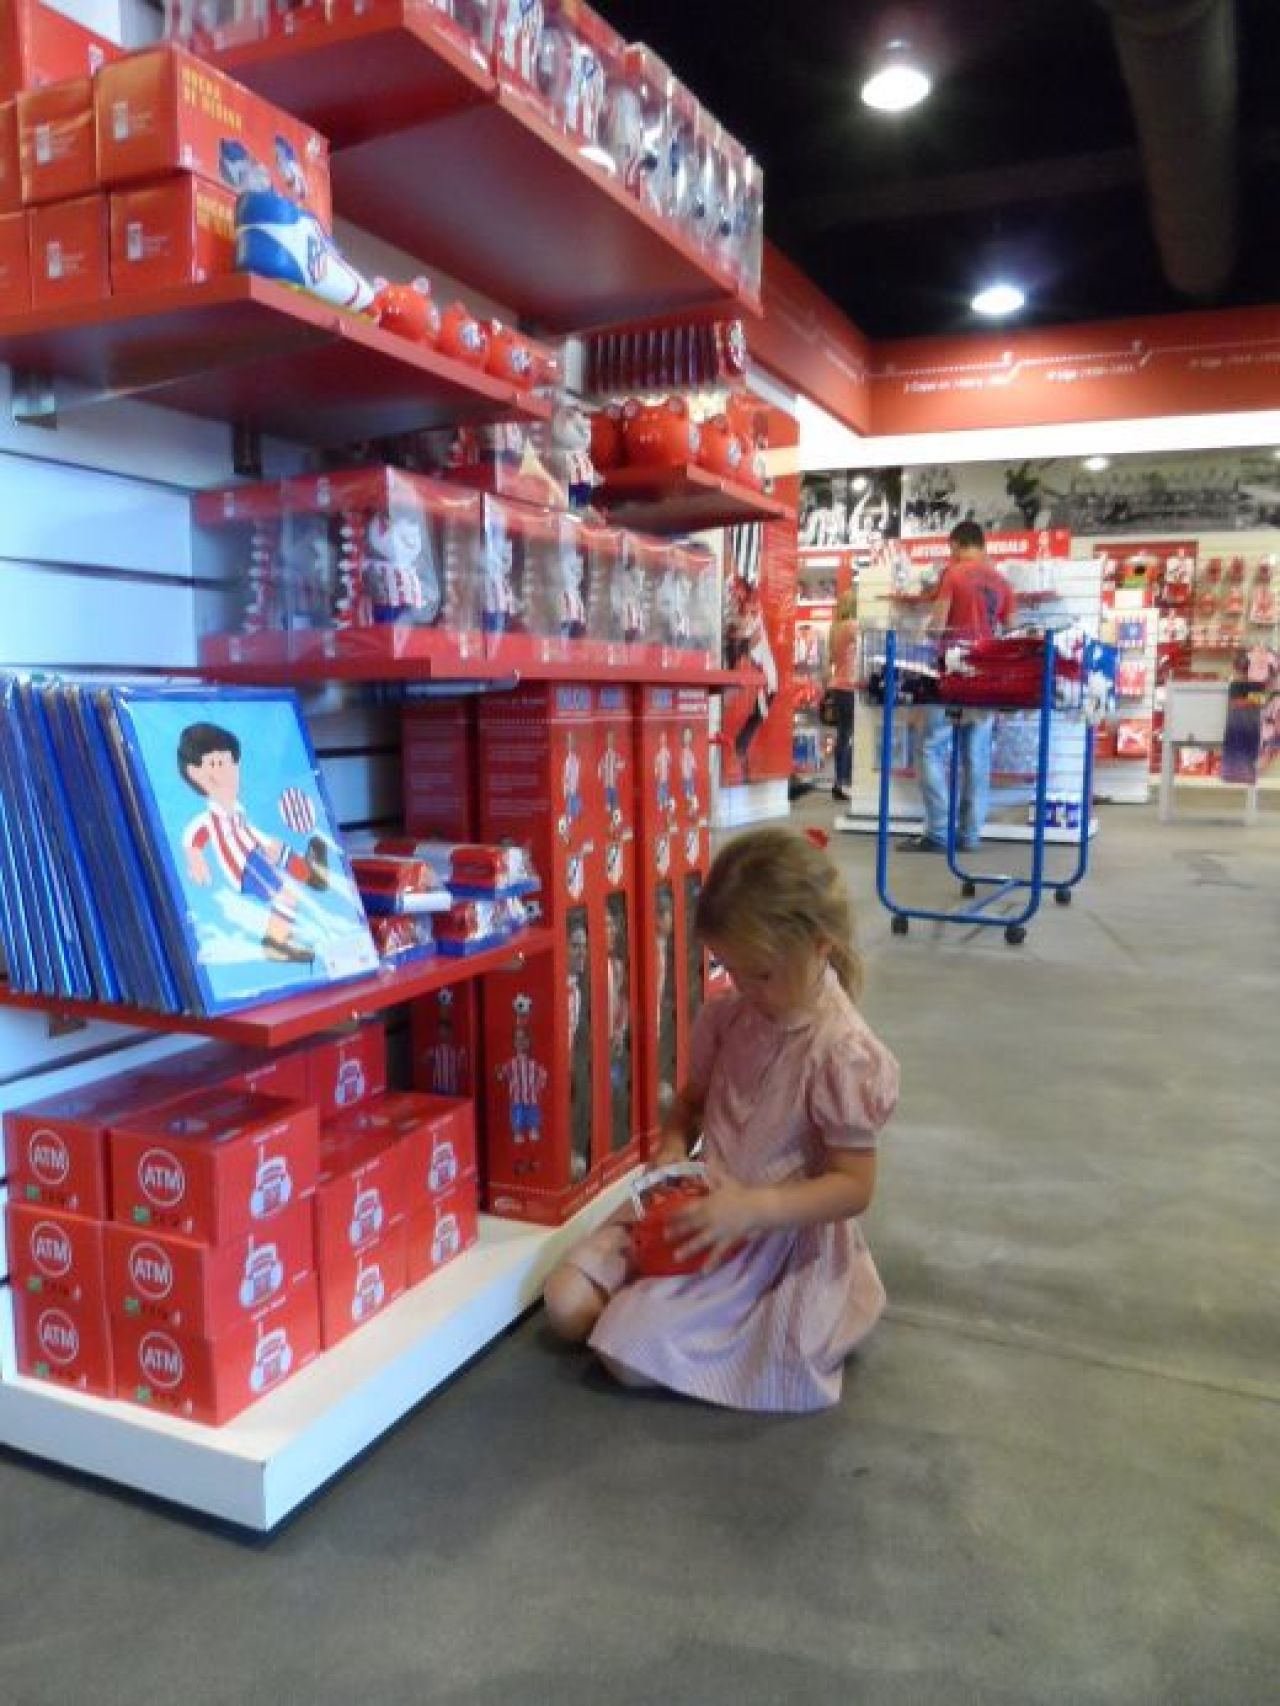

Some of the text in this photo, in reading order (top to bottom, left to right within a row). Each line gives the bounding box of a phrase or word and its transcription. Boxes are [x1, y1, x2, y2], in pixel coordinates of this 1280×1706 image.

[33, 1146, 67, 1170] ATM
[144, 1166, 183, 1190] ATM
[36, 1237, 69, 1261] ATM
[134, 1257, 171, 1284] ATM
[43, 1324, 77, 1348] ATM
[144, 1349, 179, 1372] ATM
